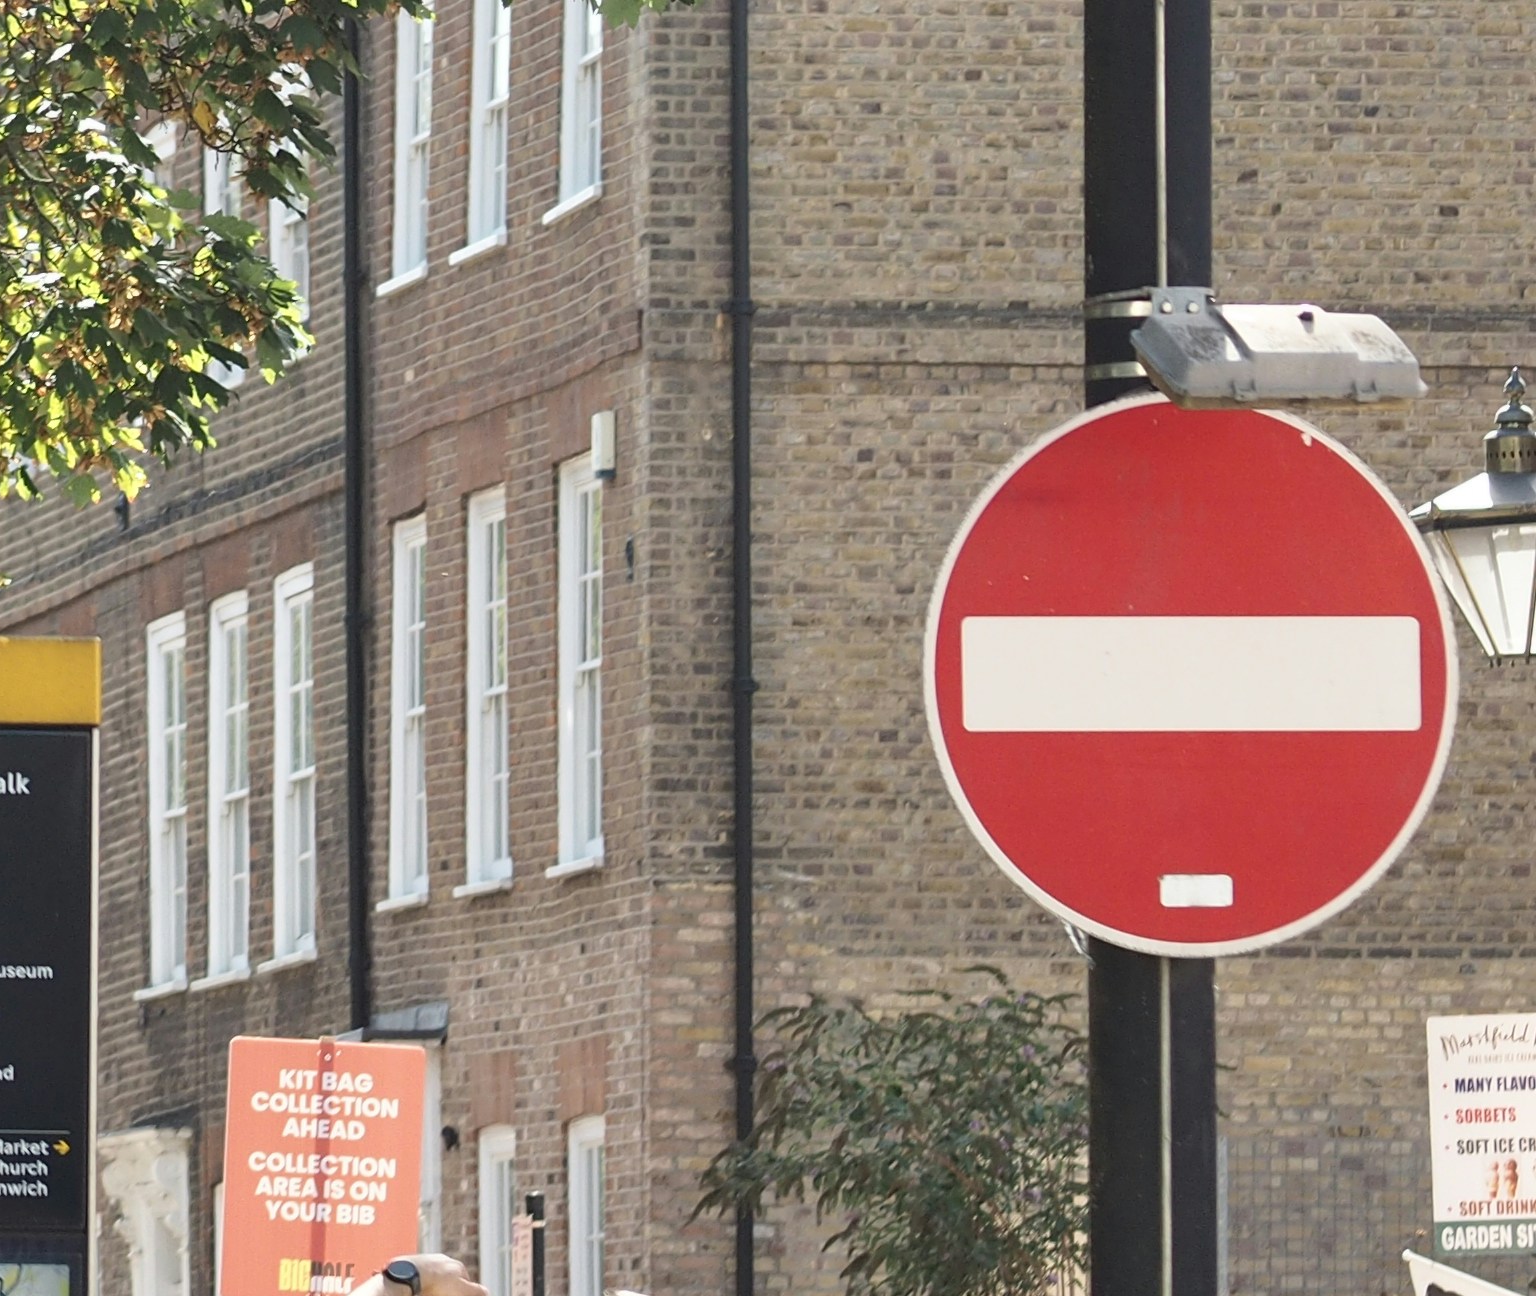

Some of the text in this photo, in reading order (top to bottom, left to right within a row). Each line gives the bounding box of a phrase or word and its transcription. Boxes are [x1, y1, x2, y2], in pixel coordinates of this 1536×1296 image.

[279, 1069, 374, 1092] KIT BAG
[1455, 1077, 1492, 1093] MANY
[251, 1092, 399, 1118] COLLECTION
[1456, 1108, 1516, 1124] SORBETS
[282, 1119, 366, 1140] AHEAD
[1457, 1139, 1490, 1154] SOFT
[1494, 1139, 1514, 1153] ICE
[248, 1153, 396, 1178] COLLECTION
[255, 1177, 386, 1201] AREA IS ON
[266, 1200, 375, 1225] YOUR BIB
[1459, 1201, 1492, 1216] SOFT
[1442, 1226, 1512, 1250] GARDEN
